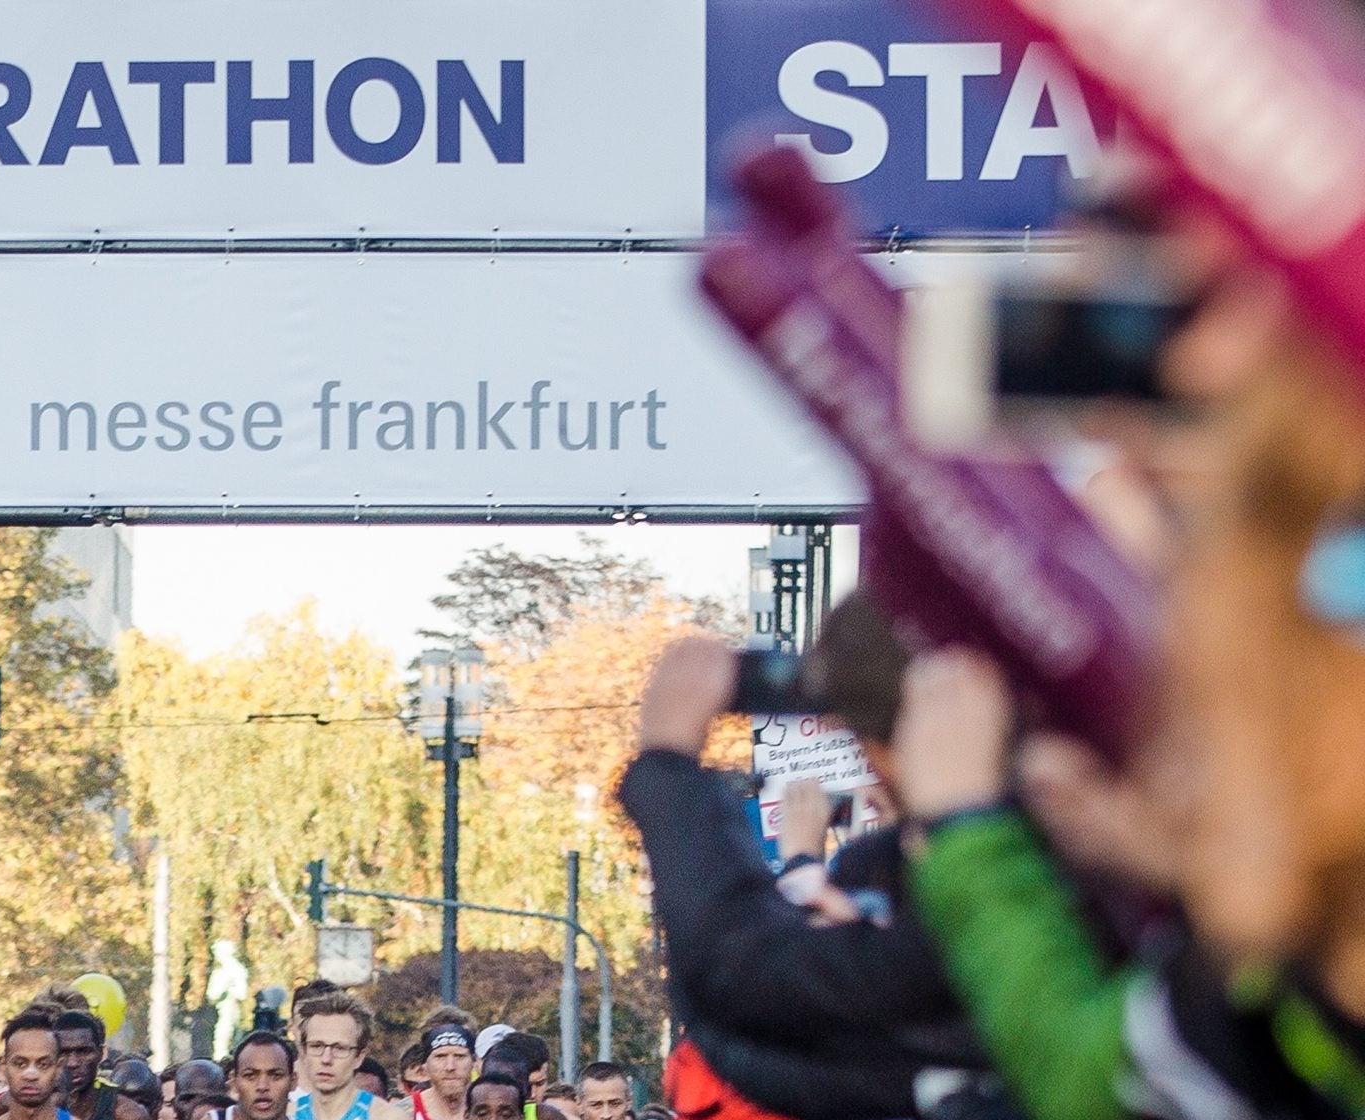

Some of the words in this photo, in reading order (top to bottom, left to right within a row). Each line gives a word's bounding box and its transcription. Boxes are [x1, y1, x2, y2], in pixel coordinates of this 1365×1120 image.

[773, 40, 1107, 184] STA
[29, 397, 284, 452] messe
[313, 379, 668, 452] frankfurt
